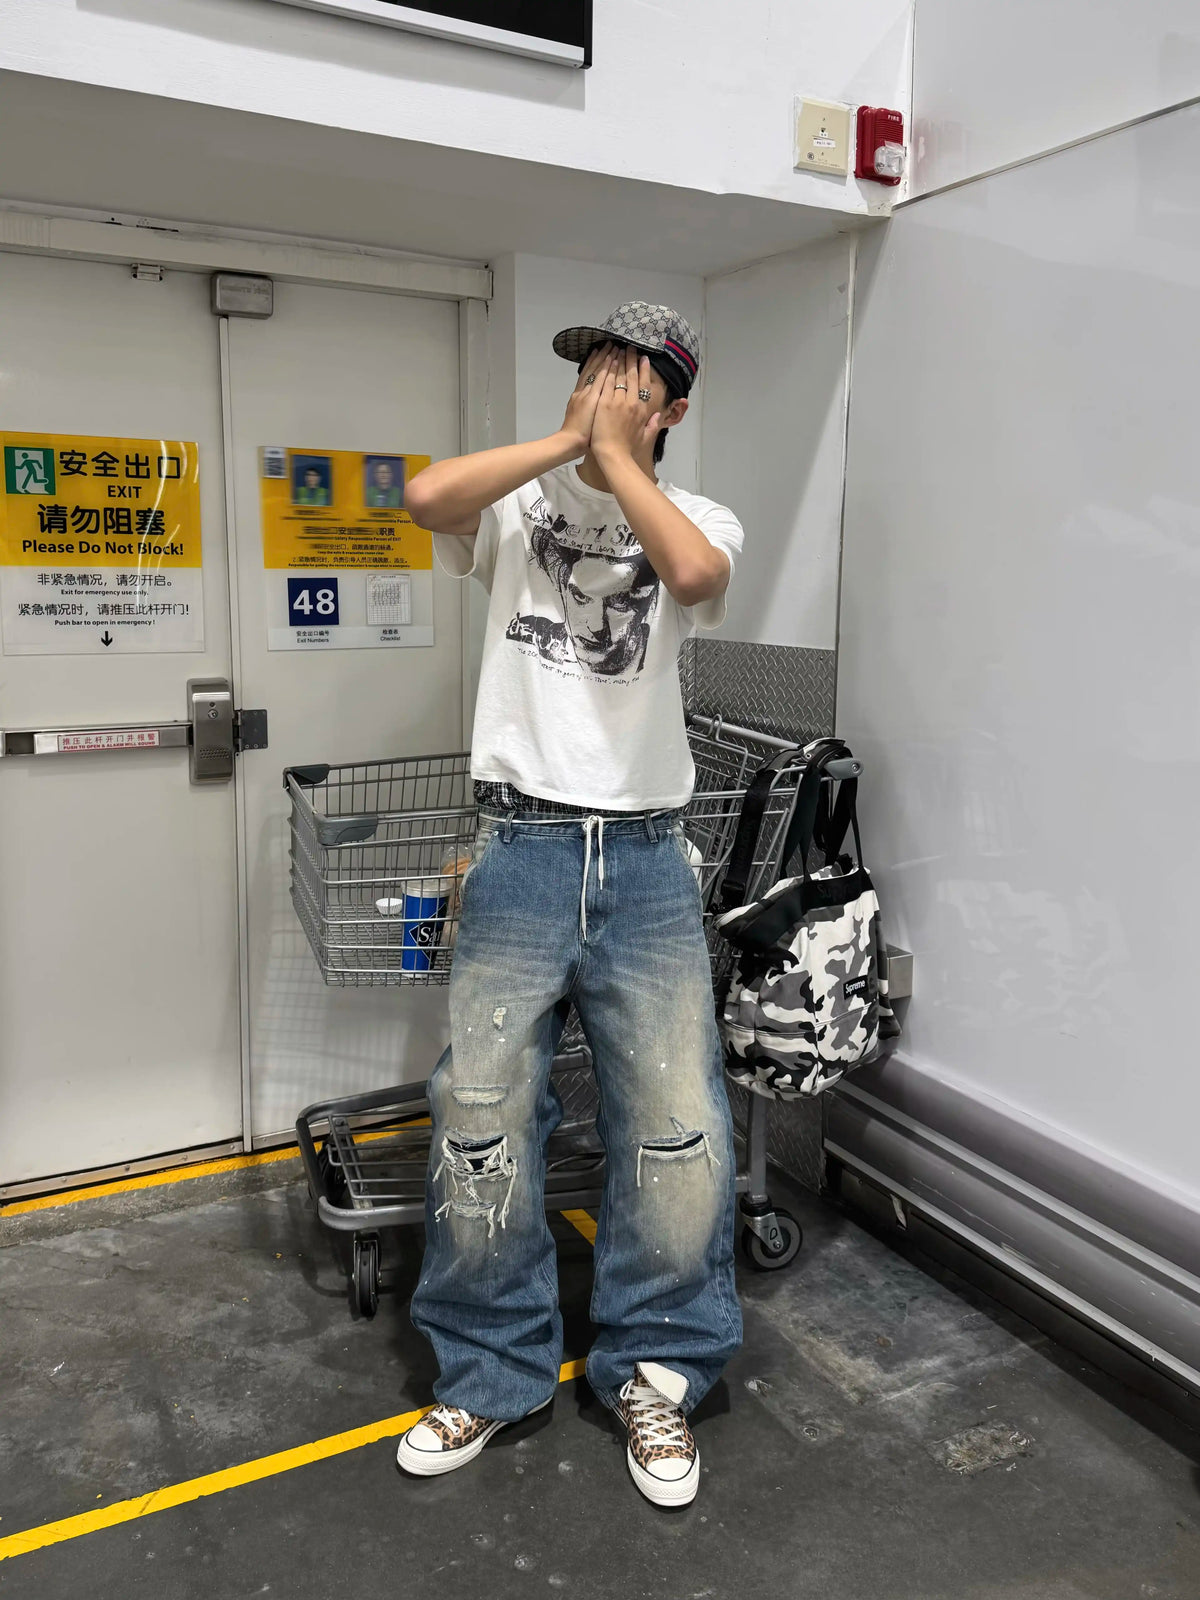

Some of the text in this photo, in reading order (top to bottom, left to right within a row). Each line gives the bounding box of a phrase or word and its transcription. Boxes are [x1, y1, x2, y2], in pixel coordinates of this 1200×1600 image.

[887, 114, 900, 122] FIRE
[59, 449, 181, 479] 安全出口
[107, 485, 142, 499] EXIT
[37, 504, 166, 536] 请勿阻塞
[22, 540, 184, 555] Please Do Not Block!
[293, 589, 335, 615] 48
[845, 980, 866, 995] Supreme
